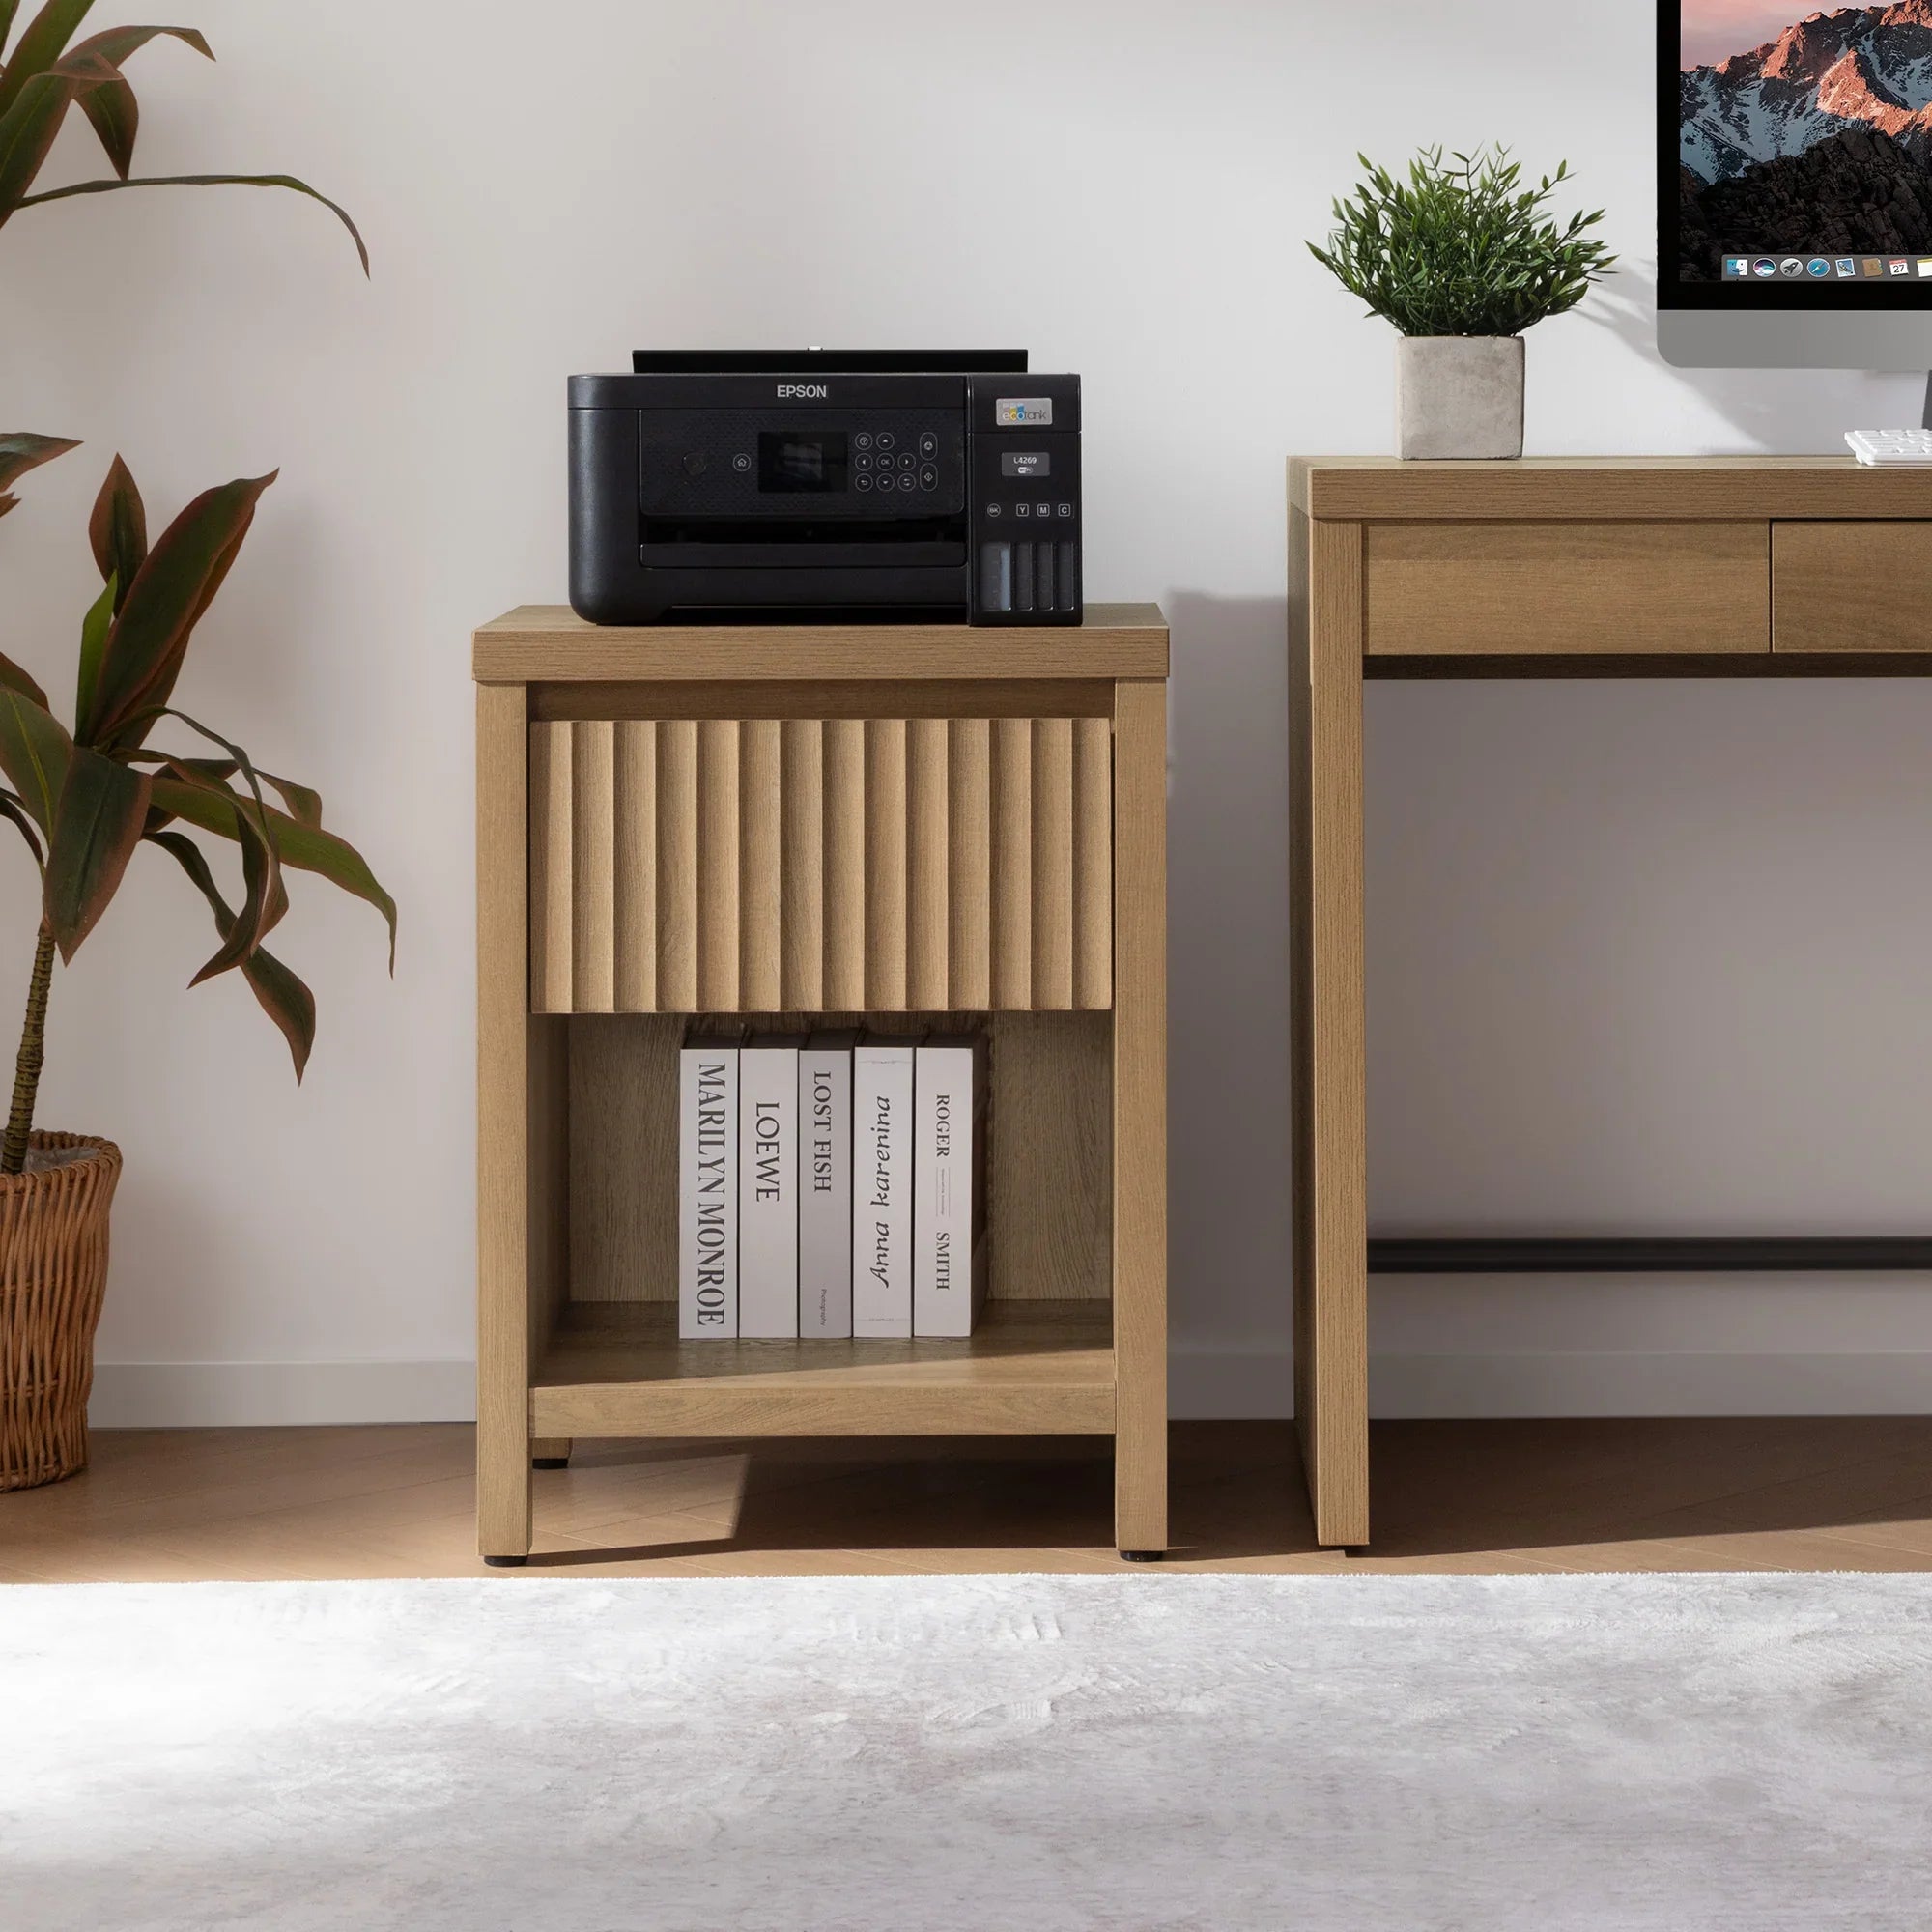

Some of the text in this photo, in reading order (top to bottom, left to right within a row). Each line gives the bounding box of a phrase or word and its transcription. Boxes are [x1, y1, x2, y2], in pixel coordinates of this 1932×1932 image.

[1892, 264, 1905, 273] 27
[777, 384, 827, 398] EPSON
[1013, 456, 1037, 465] L4269
[755, 1102, 780, 1203] LOEWE
[813, 1071, 832, 1193] LOST FISH
[936, 1094, 951, 1157] ROGER
[696, 1063, 726, 1326] MARILYN MONROE
[869, 1095, 891, 1289] Anna karenina
[936, 1232, 950, 1291] SMITH
